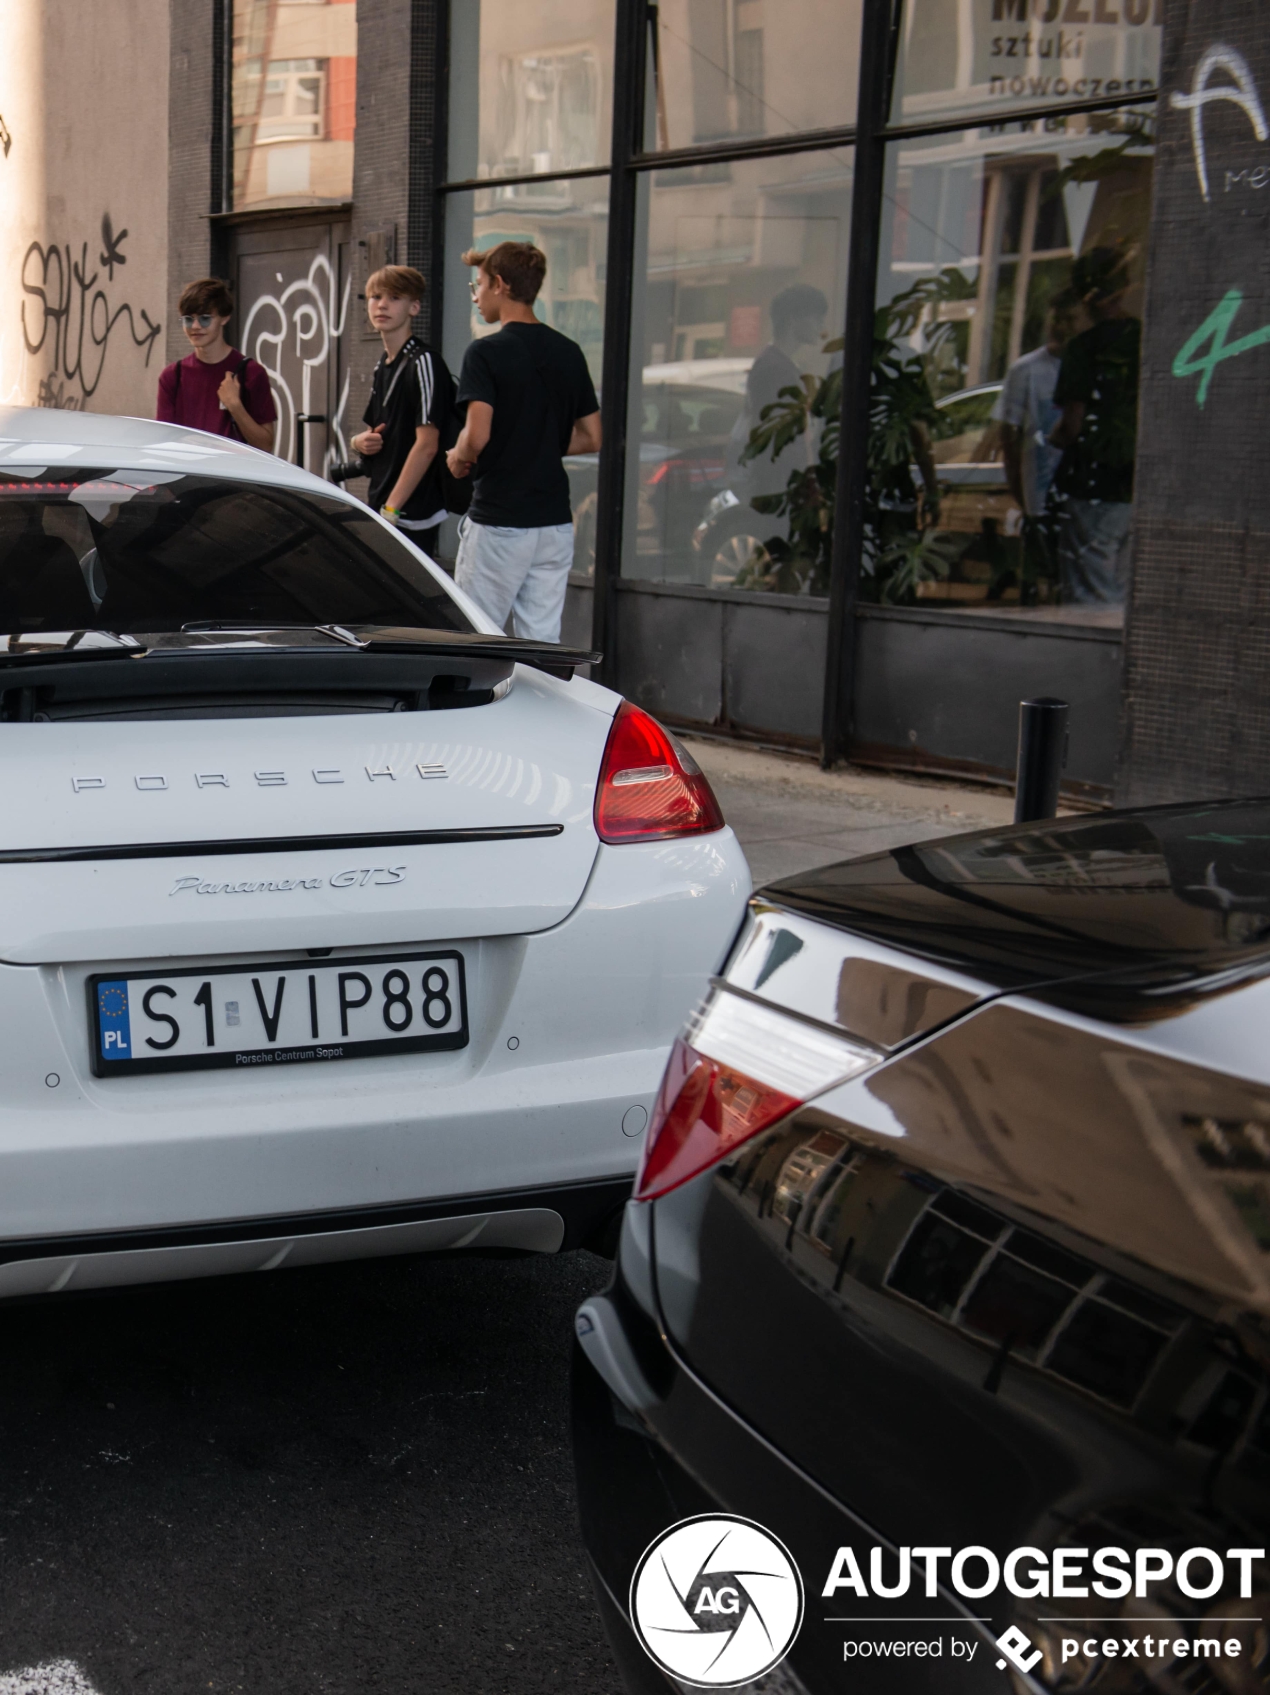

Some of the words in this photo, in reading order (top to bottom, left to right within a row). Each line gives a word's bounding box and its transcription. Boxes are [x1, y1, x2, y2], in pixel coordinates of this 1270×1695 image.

[991, 30, 1084, 59] sztuki
[72, 762, 450, 793] PORSCHE
[169, 874, 324, 896] Panamera
[330, 865, 408, 887] GTS
[251, 966, 452, 1043] VIP88
[104, 1030, 127, 1049] PL
[235, 1052, 273, 1064] Porsche
[275, 1049, 315, 1062] Centrum
[316, 1046, 344, 1059] Sopot
